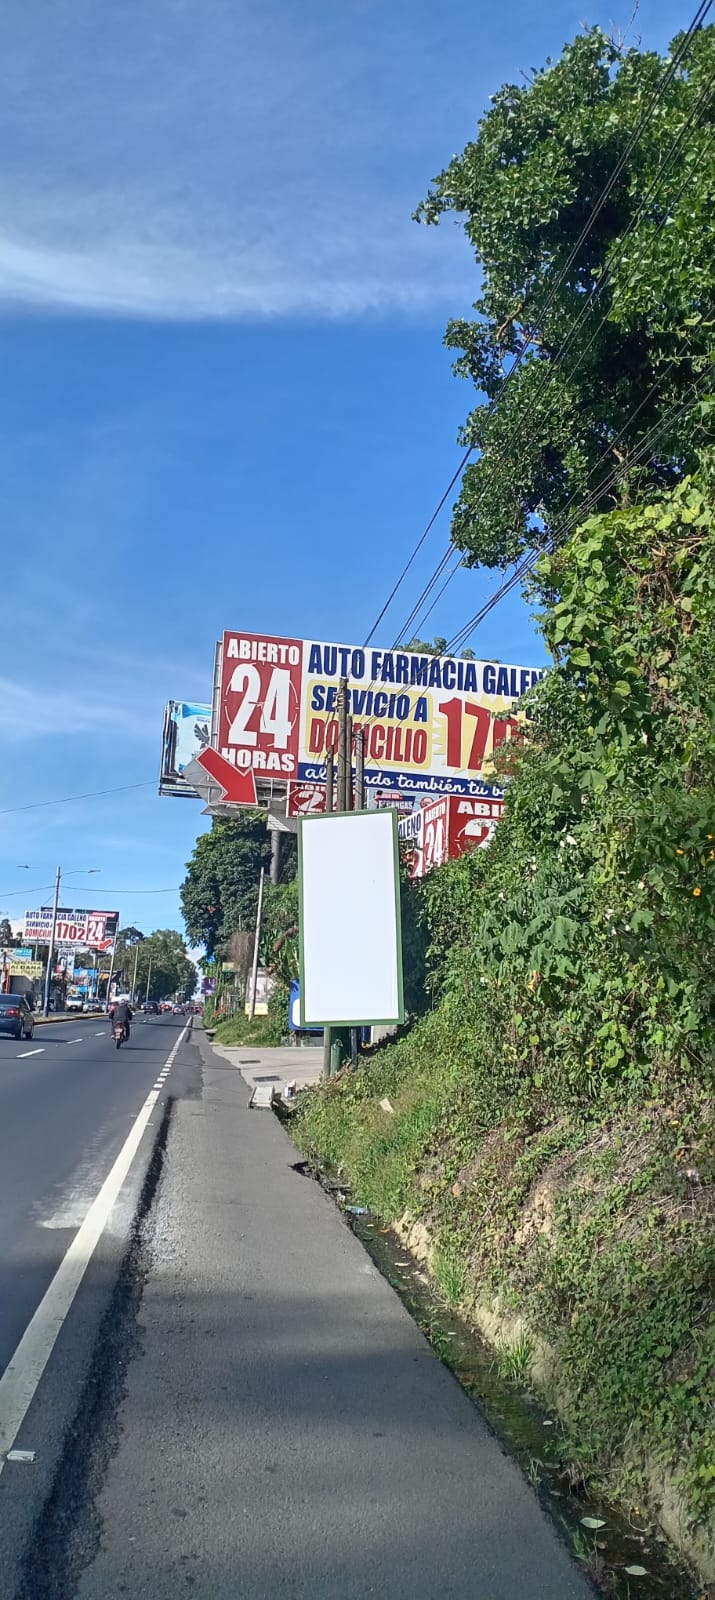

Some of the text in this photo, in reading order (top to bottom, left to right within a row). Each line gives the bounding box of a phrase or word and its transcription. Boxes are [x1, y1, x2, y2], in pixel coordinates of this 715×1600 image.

[227, 638, 300, 665] ABIERTO
[307, 644, 366, 679] AUTO
[371, 651, 478, 692] FARMACIA
[227, 663, 291, 749] 24
[414, 696, 428, 722] A
[221, 747, 295, 772] HORAS
[396, 773, 466, 793] también
[466, 781, 488, 795] tu
[56, 921, 86, 941] 1702
[87, 920, 105, 941] 24
